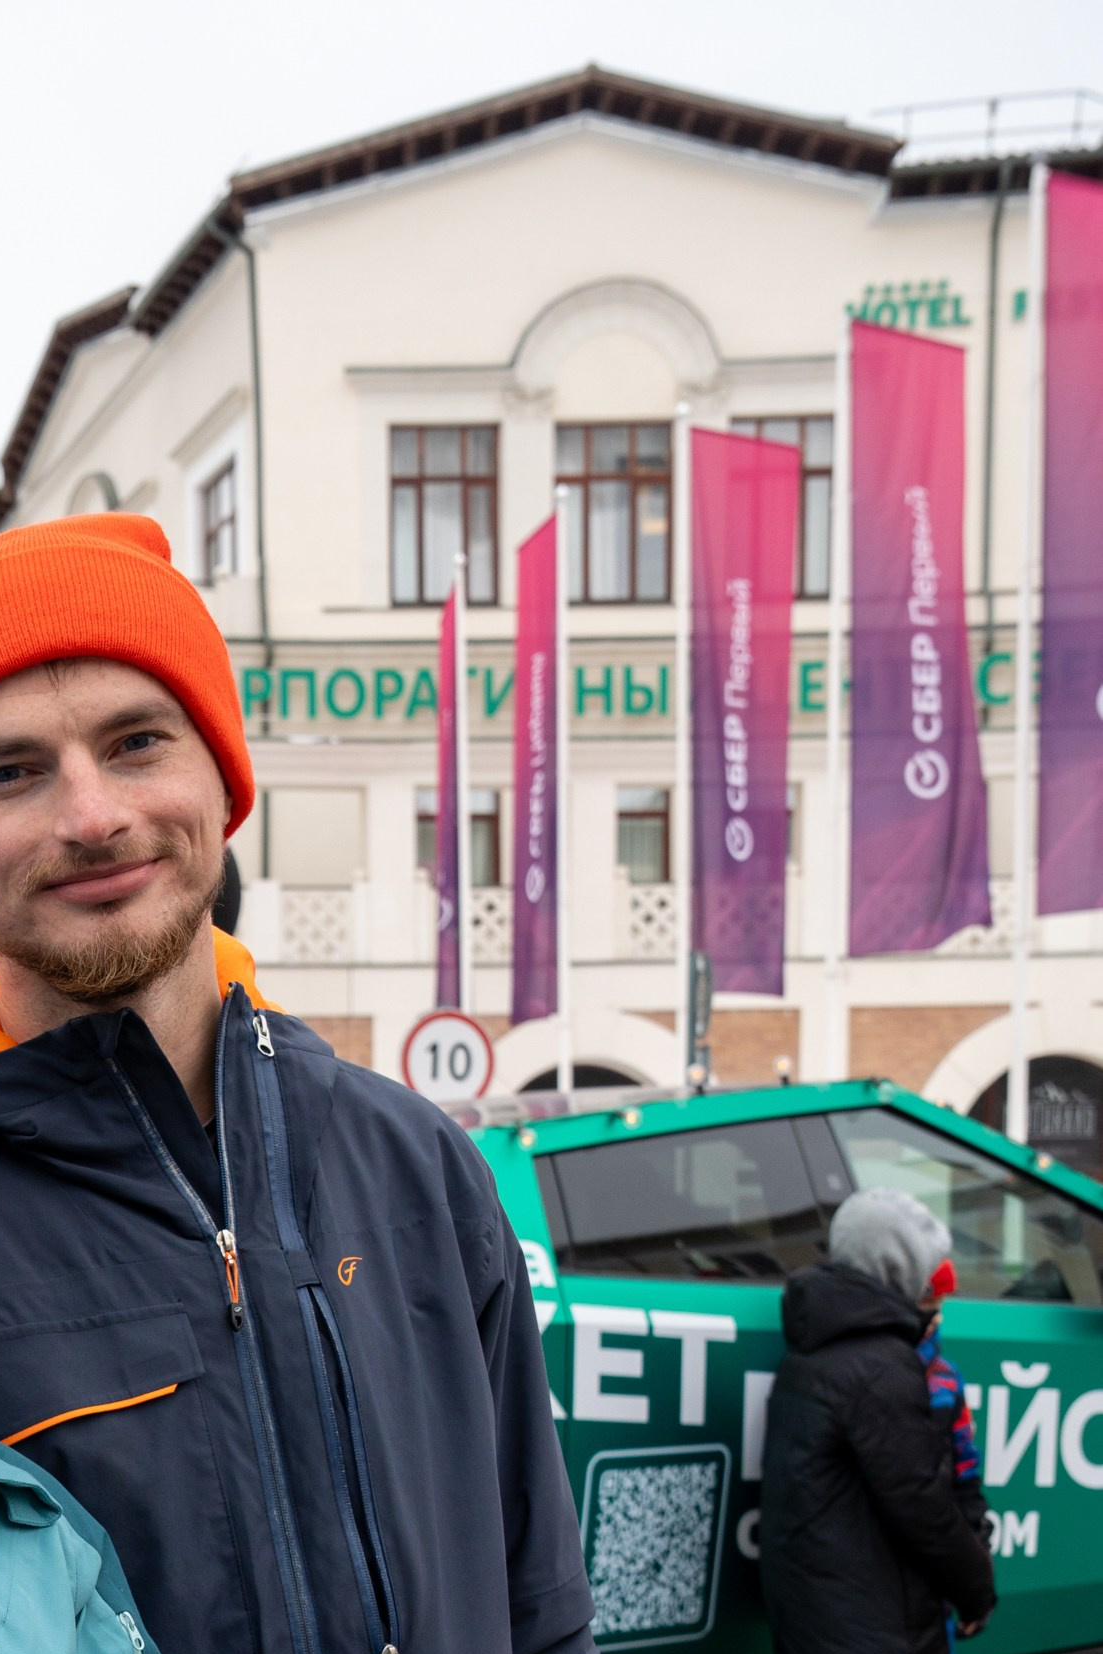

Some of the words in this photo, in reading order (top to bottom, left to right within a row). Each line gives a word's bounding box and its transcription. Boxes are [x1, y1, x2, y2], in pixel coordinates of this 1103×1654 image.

[911, 633, 942, 743] СБЕР
[724, 714, 749, 812] СБЕР
[426, 1042, 472, 1081] 10
